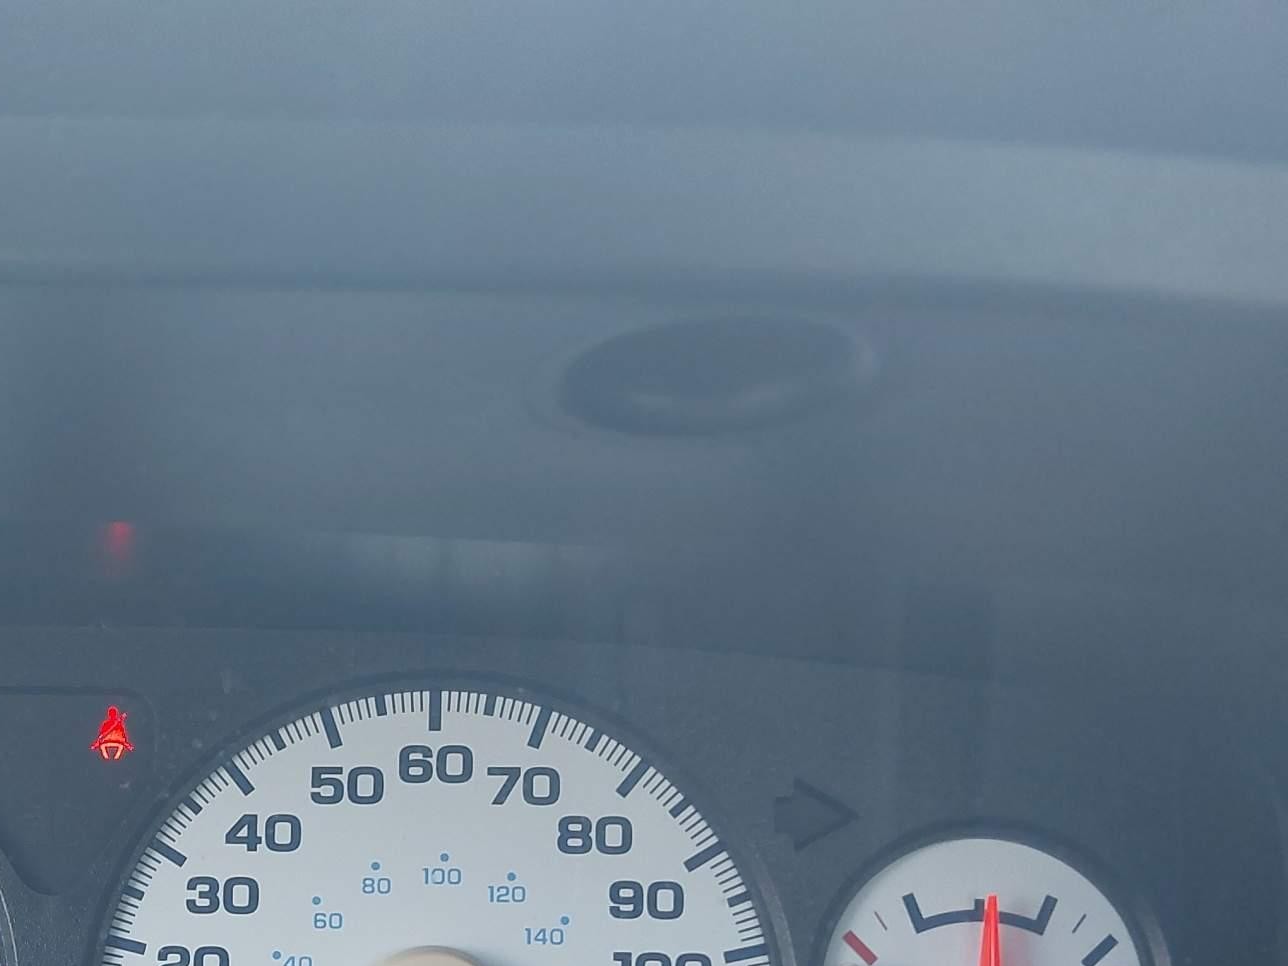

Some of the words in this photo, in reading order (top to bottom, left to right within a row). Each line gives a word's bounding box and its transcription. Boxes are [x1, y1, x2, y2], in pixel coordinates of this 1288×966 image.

[399, 745, 473, 783] 60
[311, 766, 384, 804] 50
[487, 767, 560, 805] 70
[225, 814, 302, 852] 40
[557, 815, 632, 854] 80
[186, 876, 259, 915] 30
[362, 877, 391, 895] 80
[422, 868, 462, 886] 100
[487, 885, 526, 903] 120
[609, 880, 683, 919] 90
[313, 912, 343, 930] 60
[525, 928, 564, 946] 140
